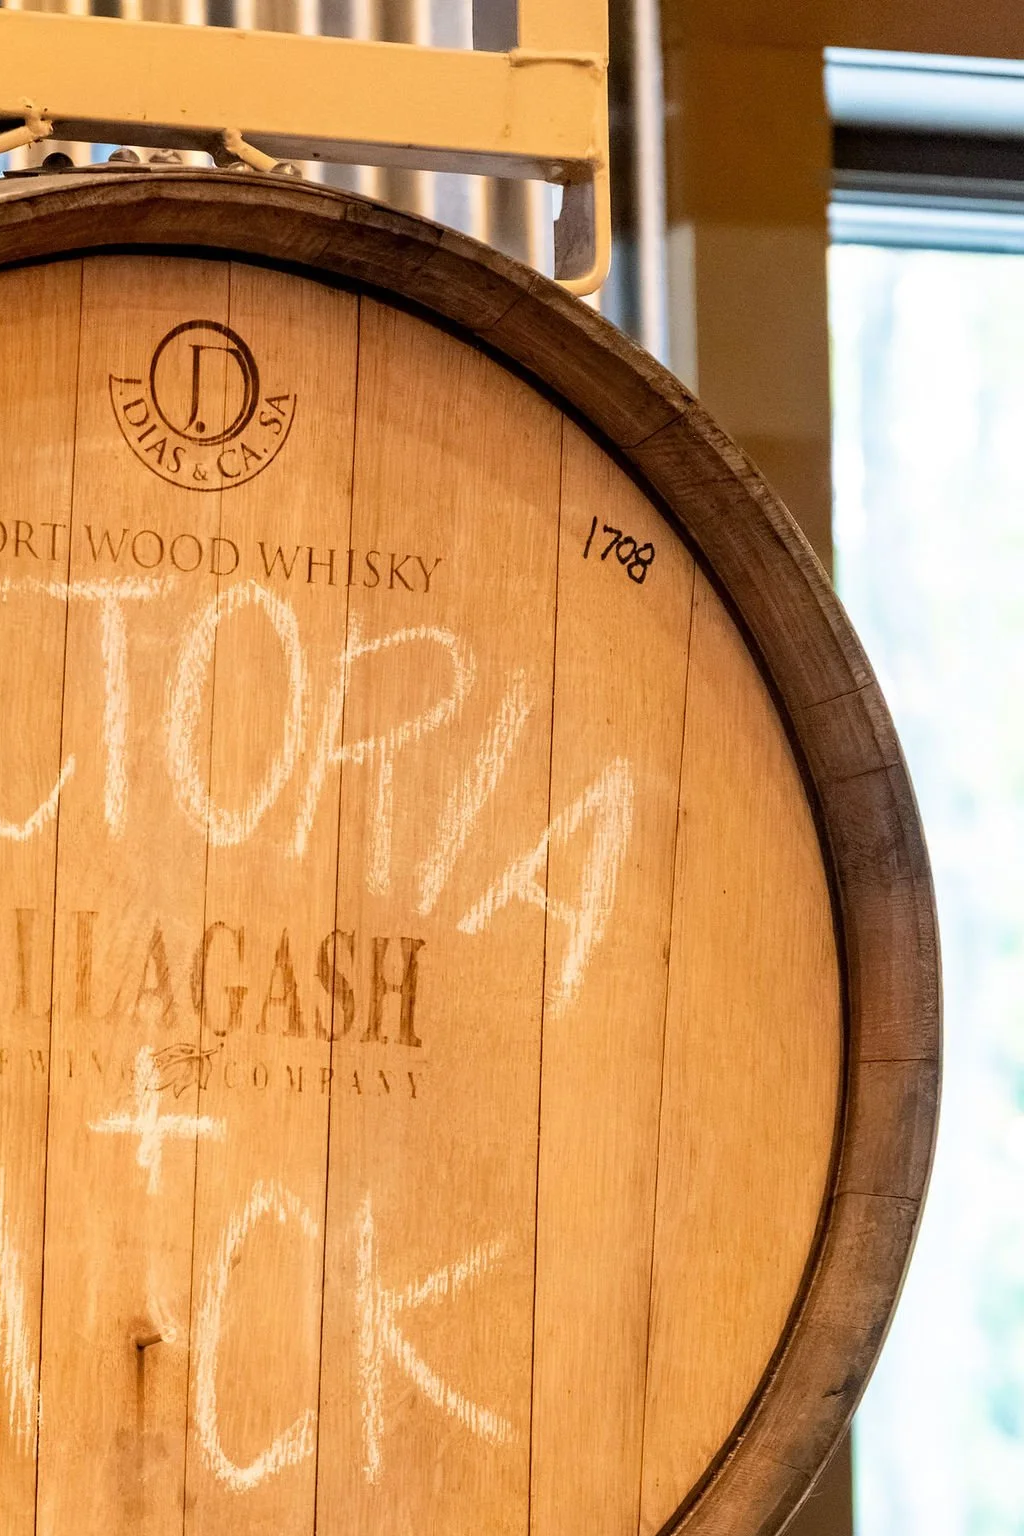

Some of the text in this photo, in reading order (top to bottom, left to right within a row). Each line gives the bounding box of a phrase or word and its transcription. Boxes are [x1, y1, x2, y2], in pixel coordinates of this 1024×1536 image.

[122, 397, 187, 474] DIAS
[192, 462, 209, 482] &
[259, 393, 290, 436] SA
[83, 524, 241, 577] WOOD
[257, 540, 443, 594] WHISKY
[583, 515, 656, 584] 1708
[224, 1060, 423, 1099] COMPANY
